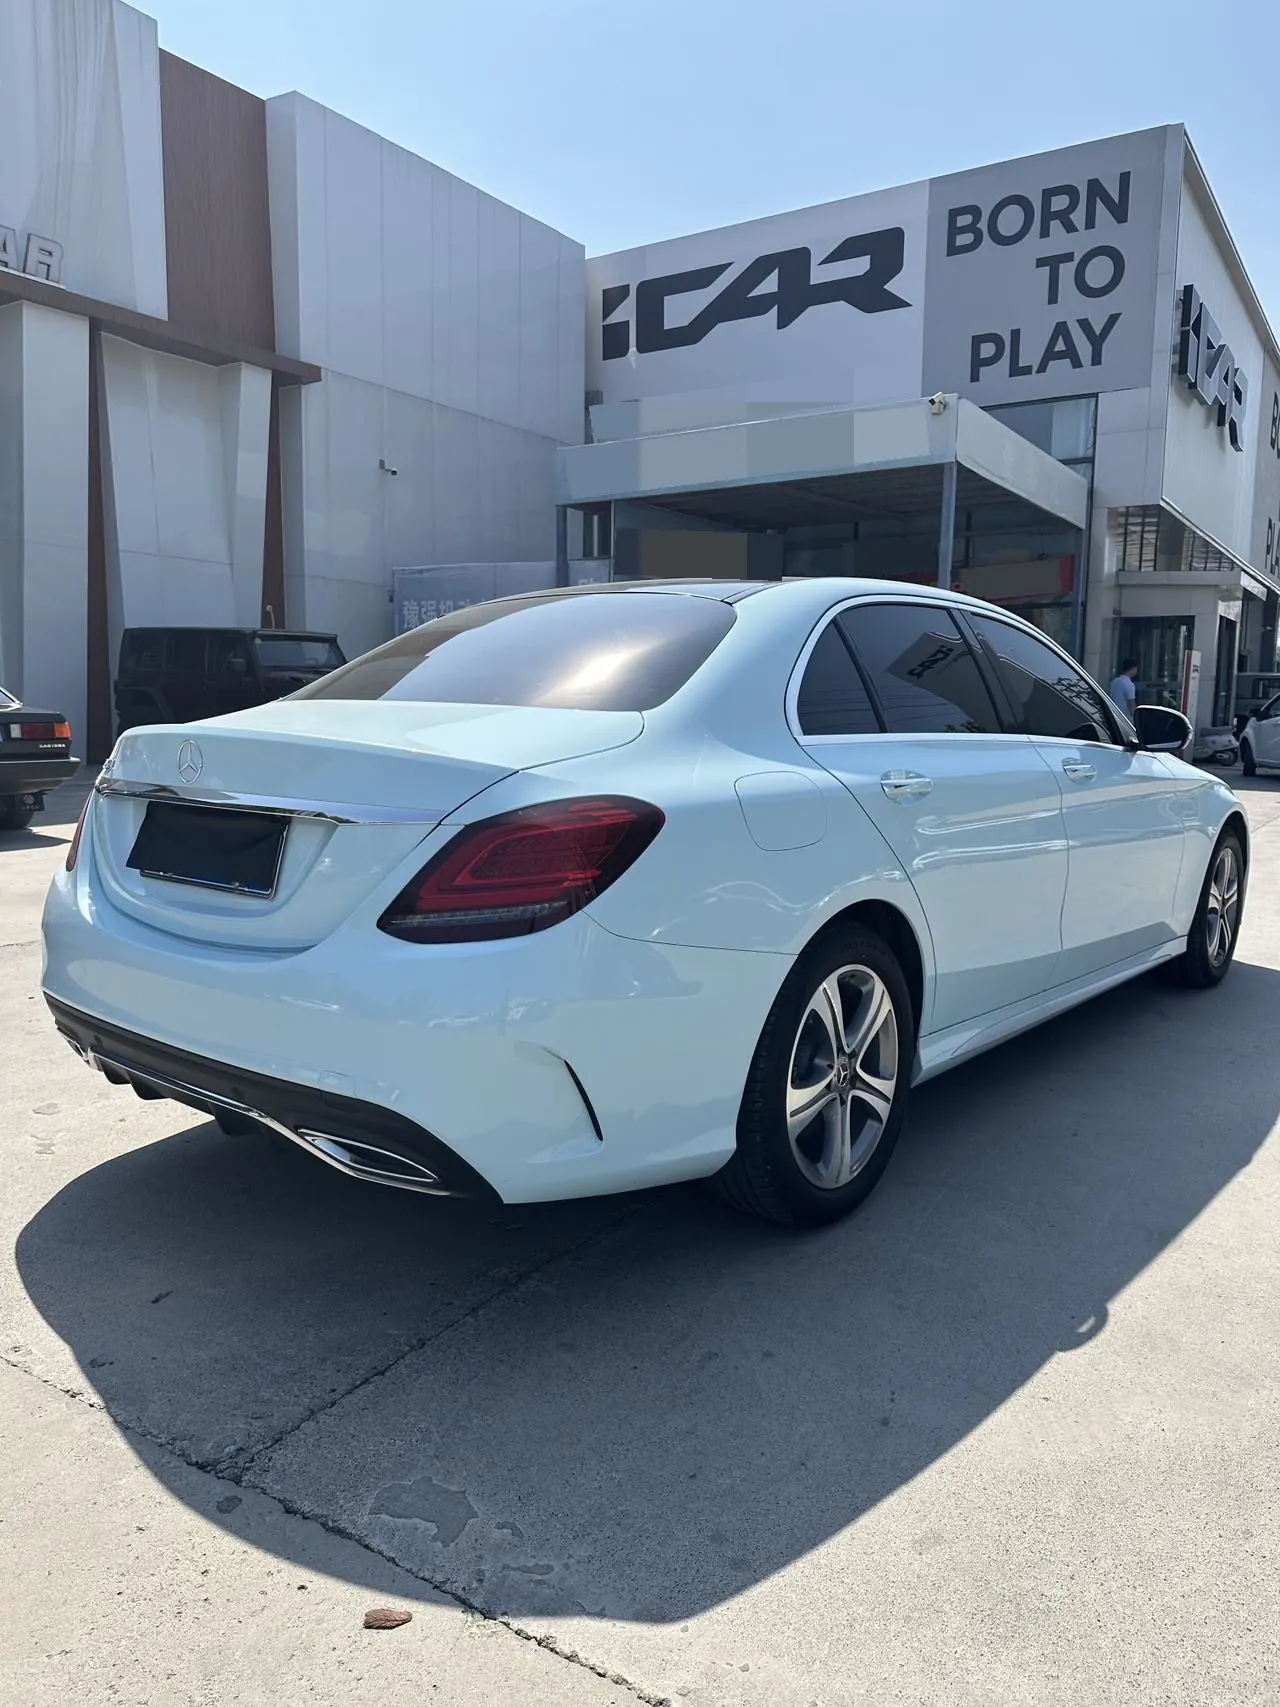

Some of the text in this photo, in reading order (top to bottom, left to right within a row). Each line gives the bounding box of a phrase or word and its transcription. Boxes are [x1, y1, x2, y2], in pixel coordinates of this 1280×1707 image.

[945, 170, 1131, 257] BORN
[1035, 244, 1126, 305] TO
[969, 312, 1122, 383] PLAY
